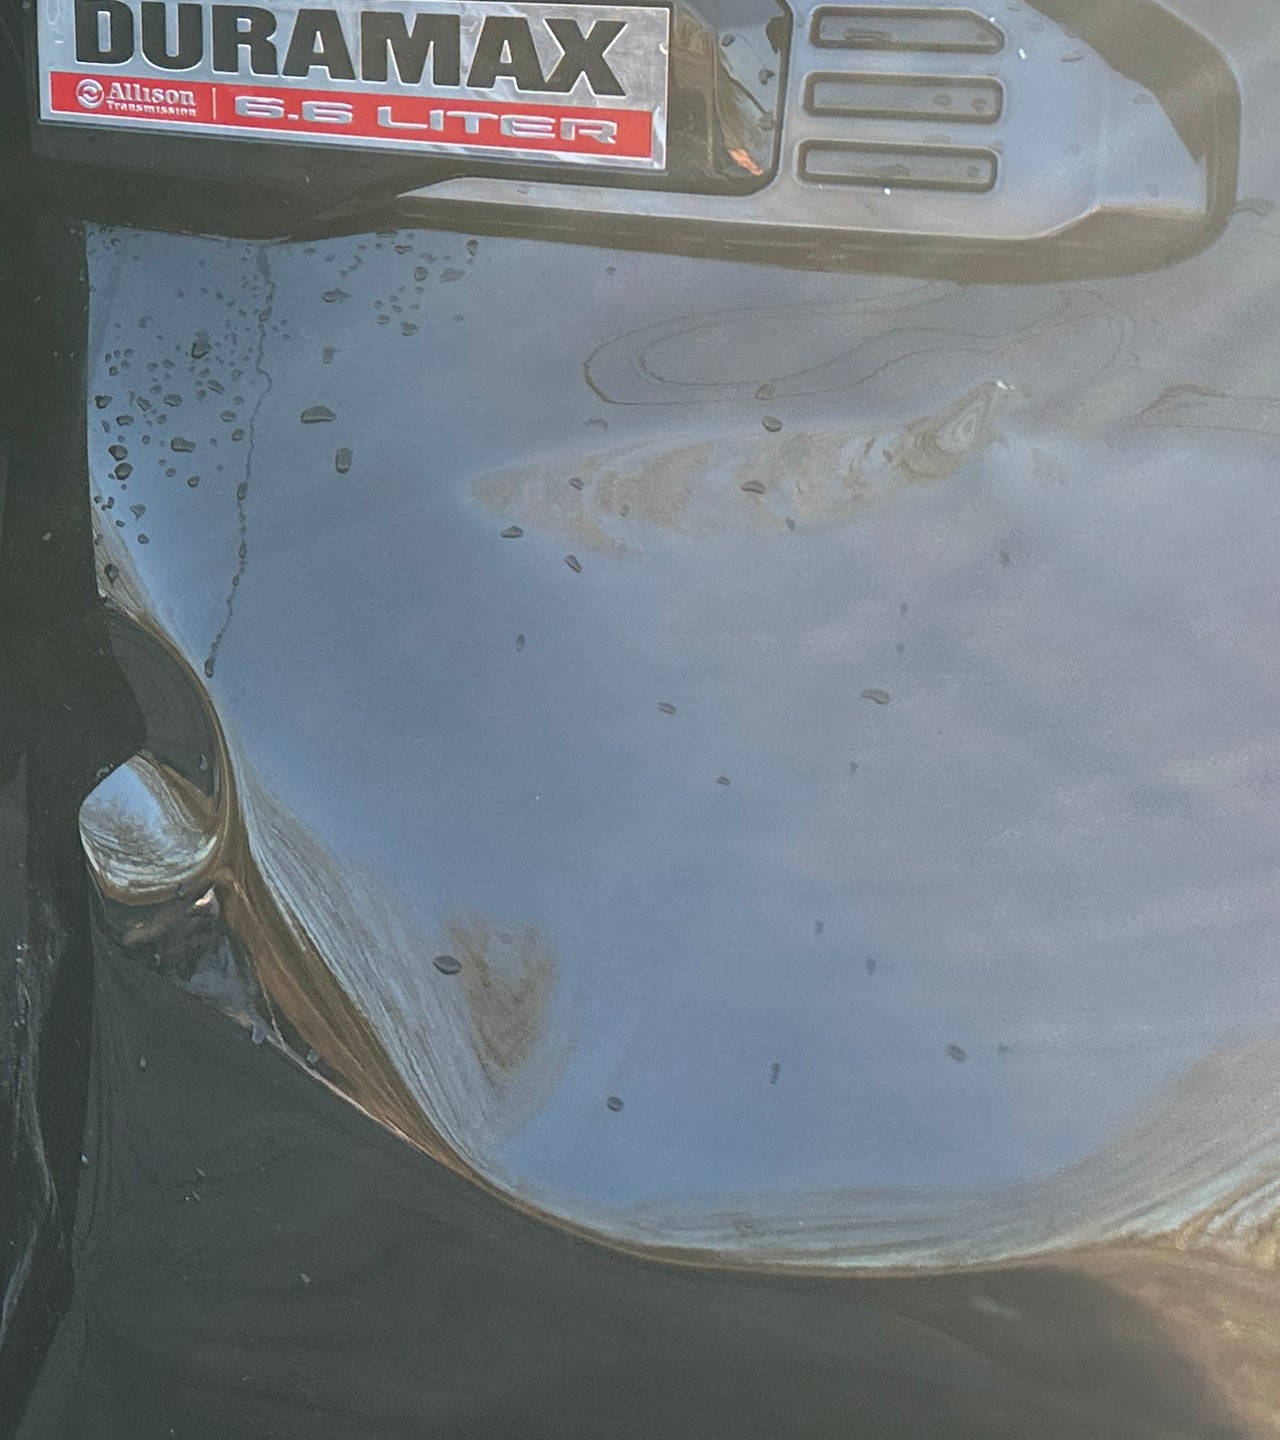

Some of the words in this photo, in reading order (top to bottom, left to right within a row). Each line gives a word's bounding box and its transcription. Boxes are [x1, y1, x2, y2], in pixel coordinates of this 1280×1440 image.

[105, 81, 197, 107] Allison
[105, 99, 198, 117] Transmission
[234, 95, 354, 125] 6.6
[376, 105, 619, 145] LITER
